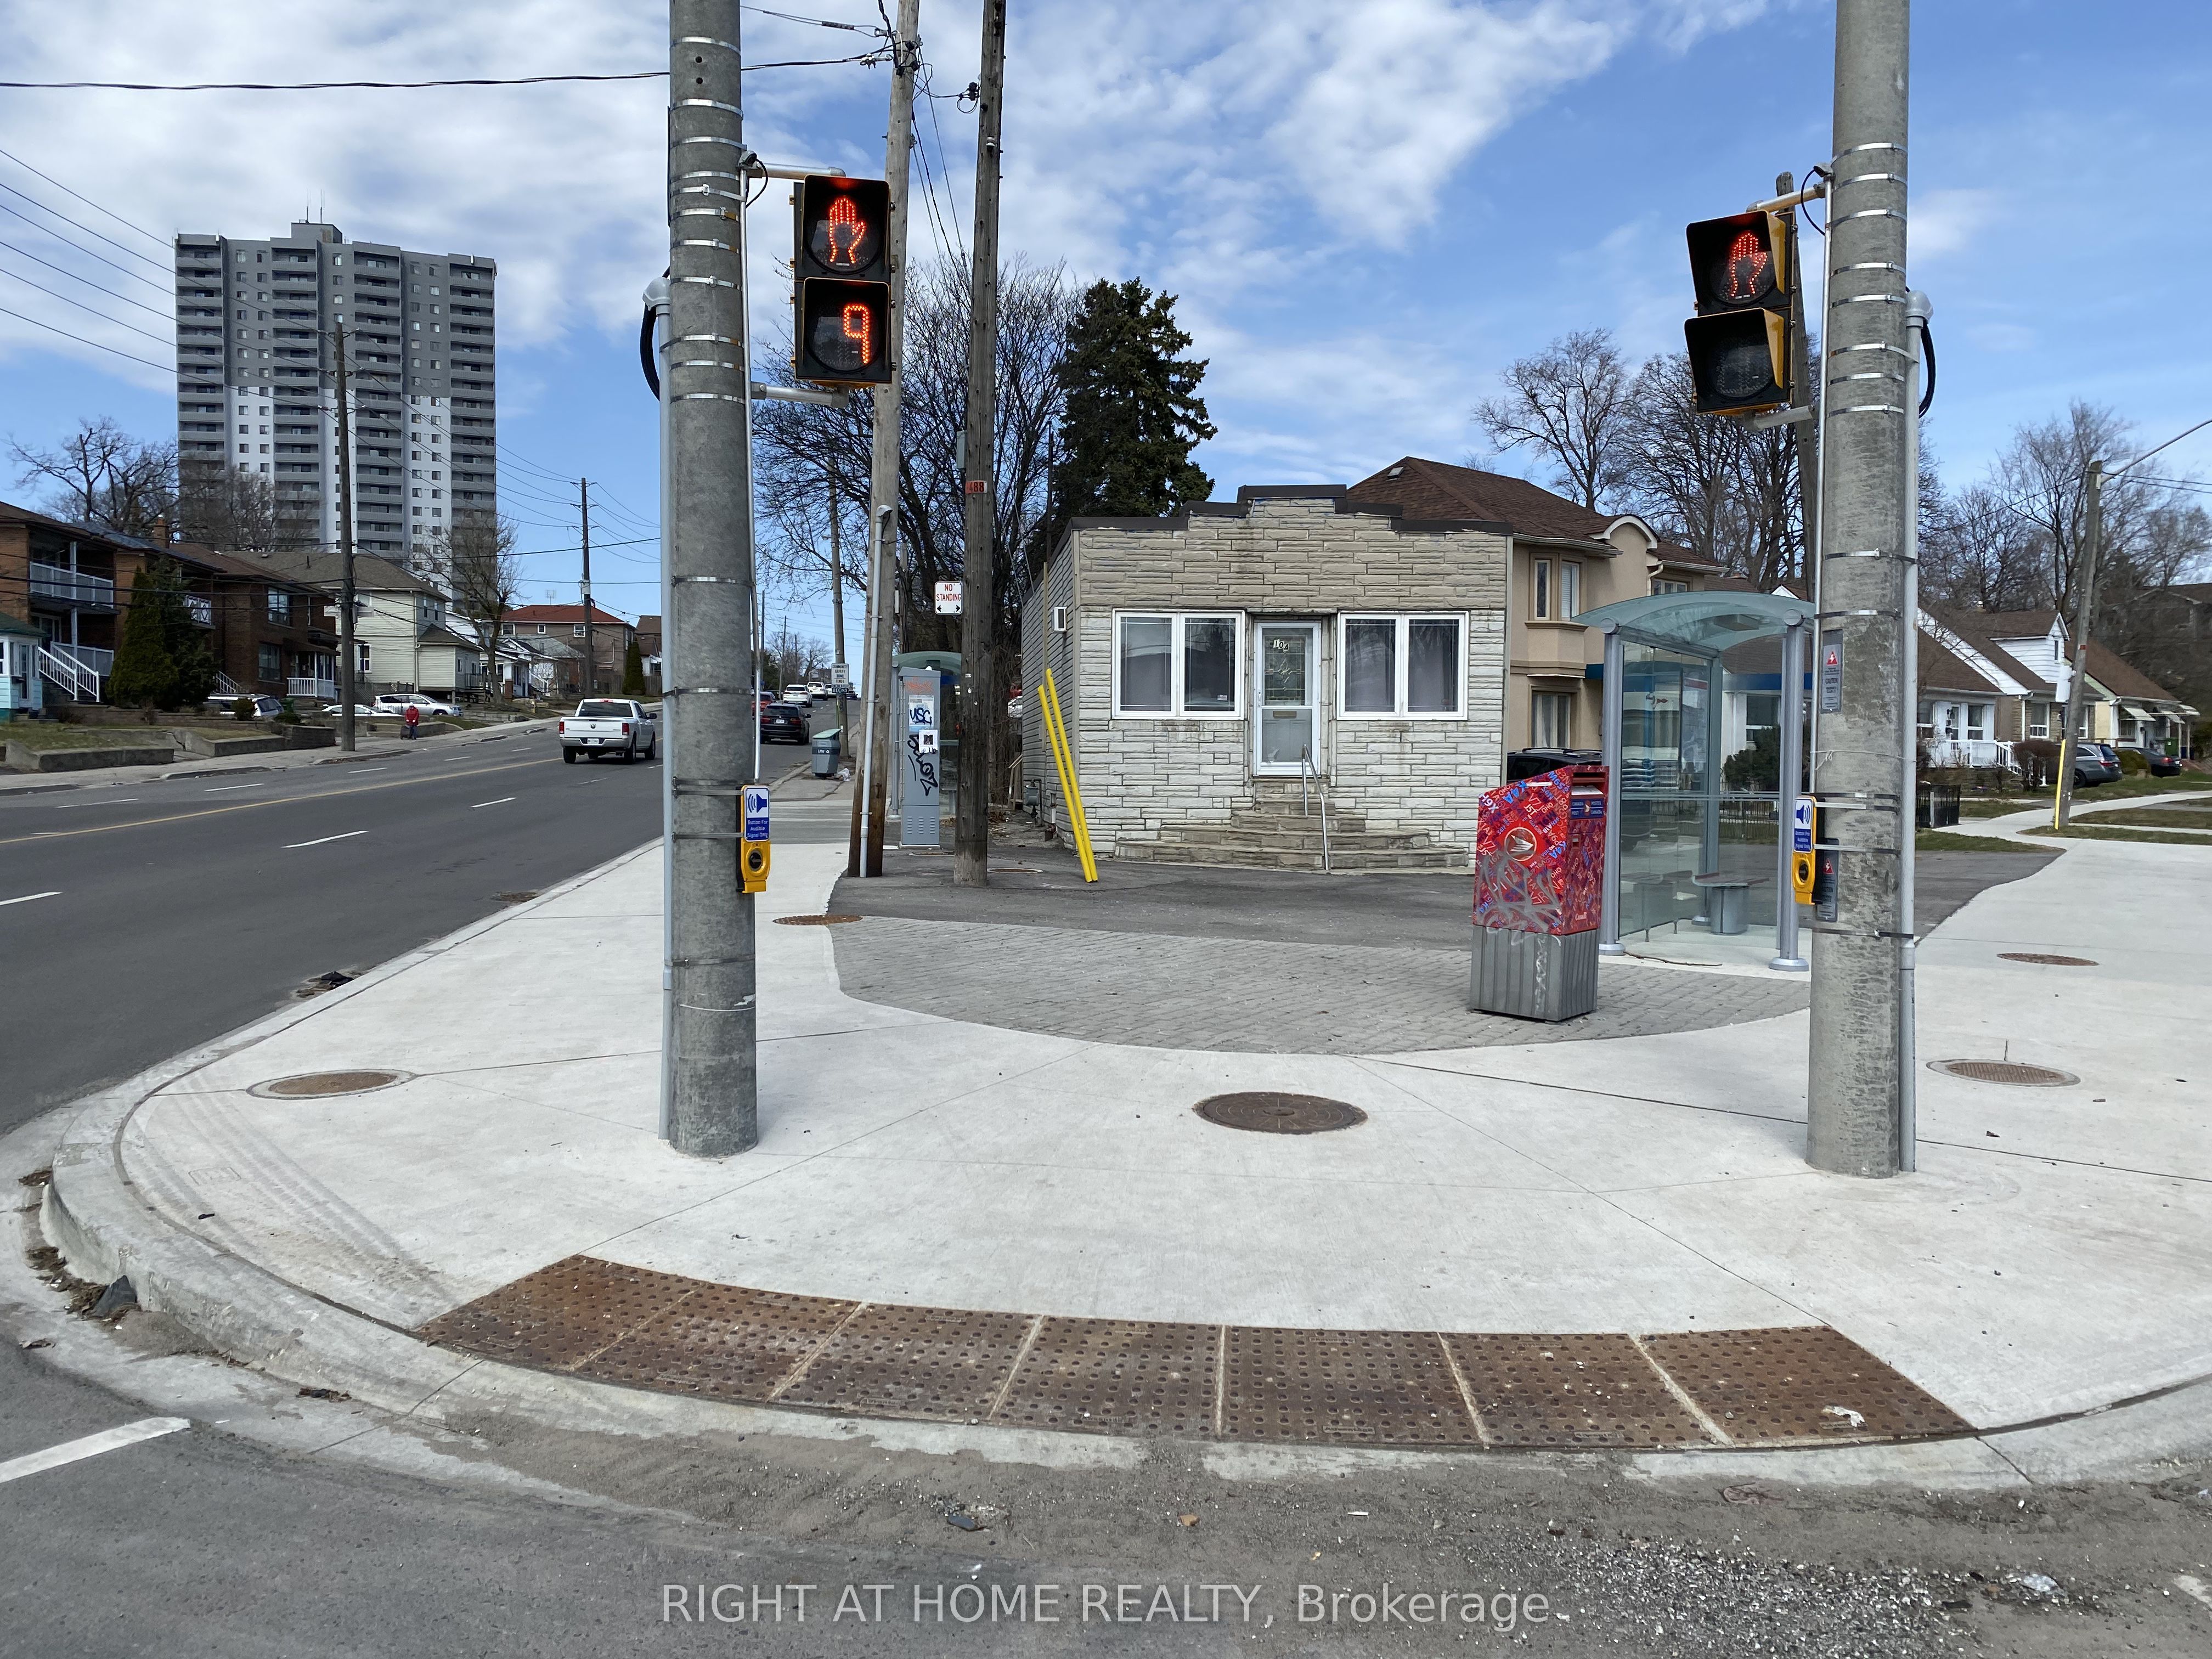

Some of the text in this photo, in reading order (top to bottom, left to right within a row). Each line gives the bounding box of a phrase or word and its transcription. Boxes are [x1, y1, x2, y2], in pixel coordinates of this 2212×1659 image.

[843, 303, 870, 365] 9
[944, 583, 953, 592] NO
[936, 593, 962, 601] STANDING
[1275, 640, 1289, 651] 104
[1479, 793, 1499, 814] H9X
